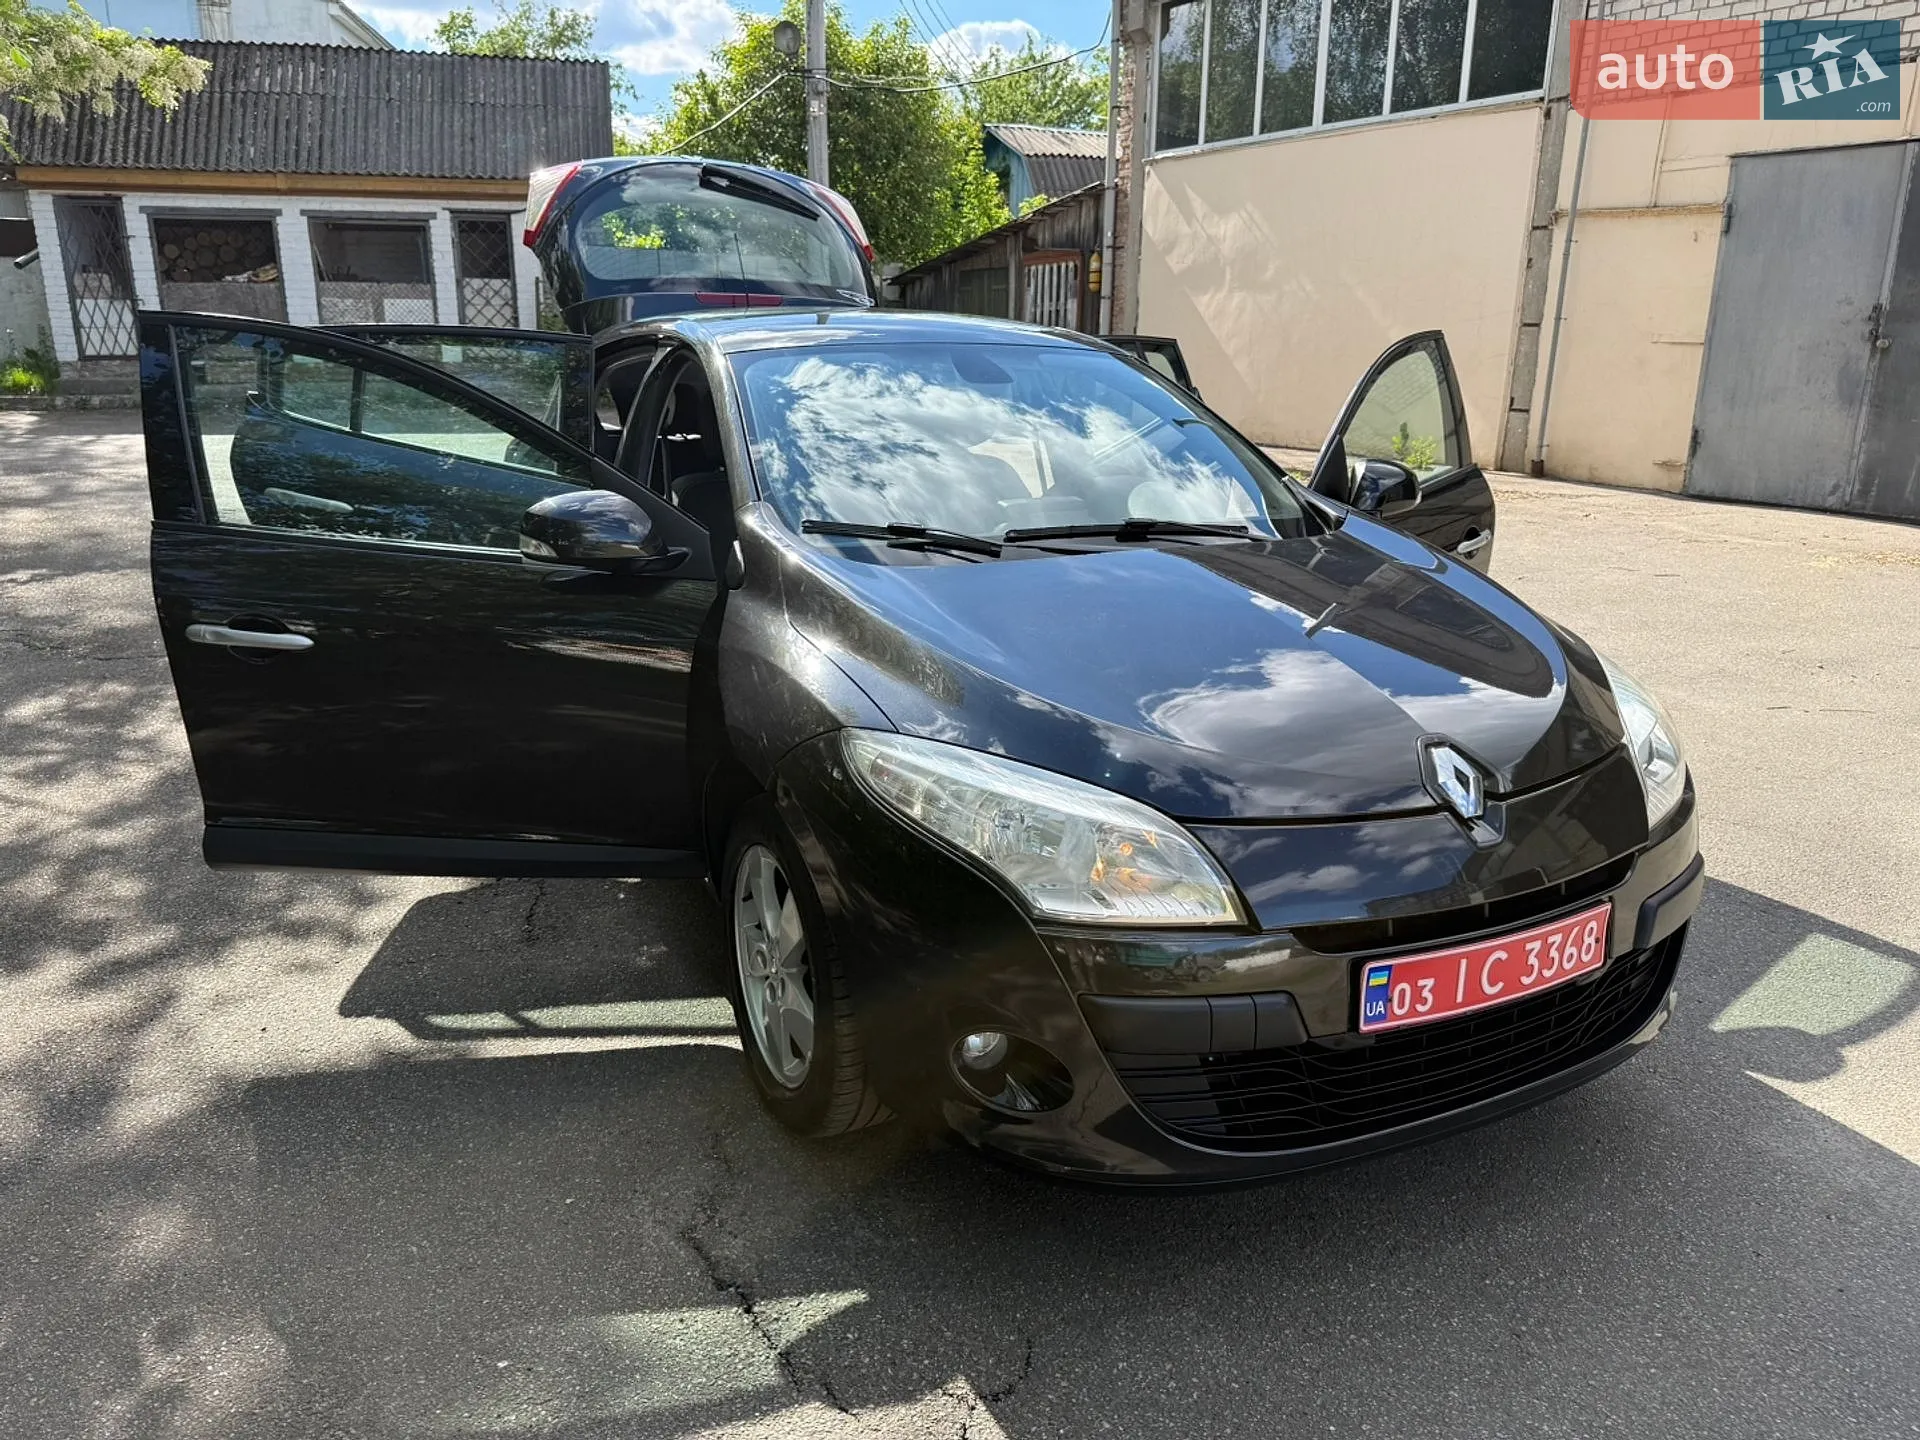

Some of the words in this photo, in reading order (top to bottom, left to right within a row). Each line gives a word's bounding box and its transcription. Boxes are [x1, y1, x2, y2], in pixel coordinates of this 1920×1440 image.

[1391, 978, 1435, 1016] 03
[1519, 920, 1600, 986] 3368
[1366, 1002, 1385, 1016] UA
